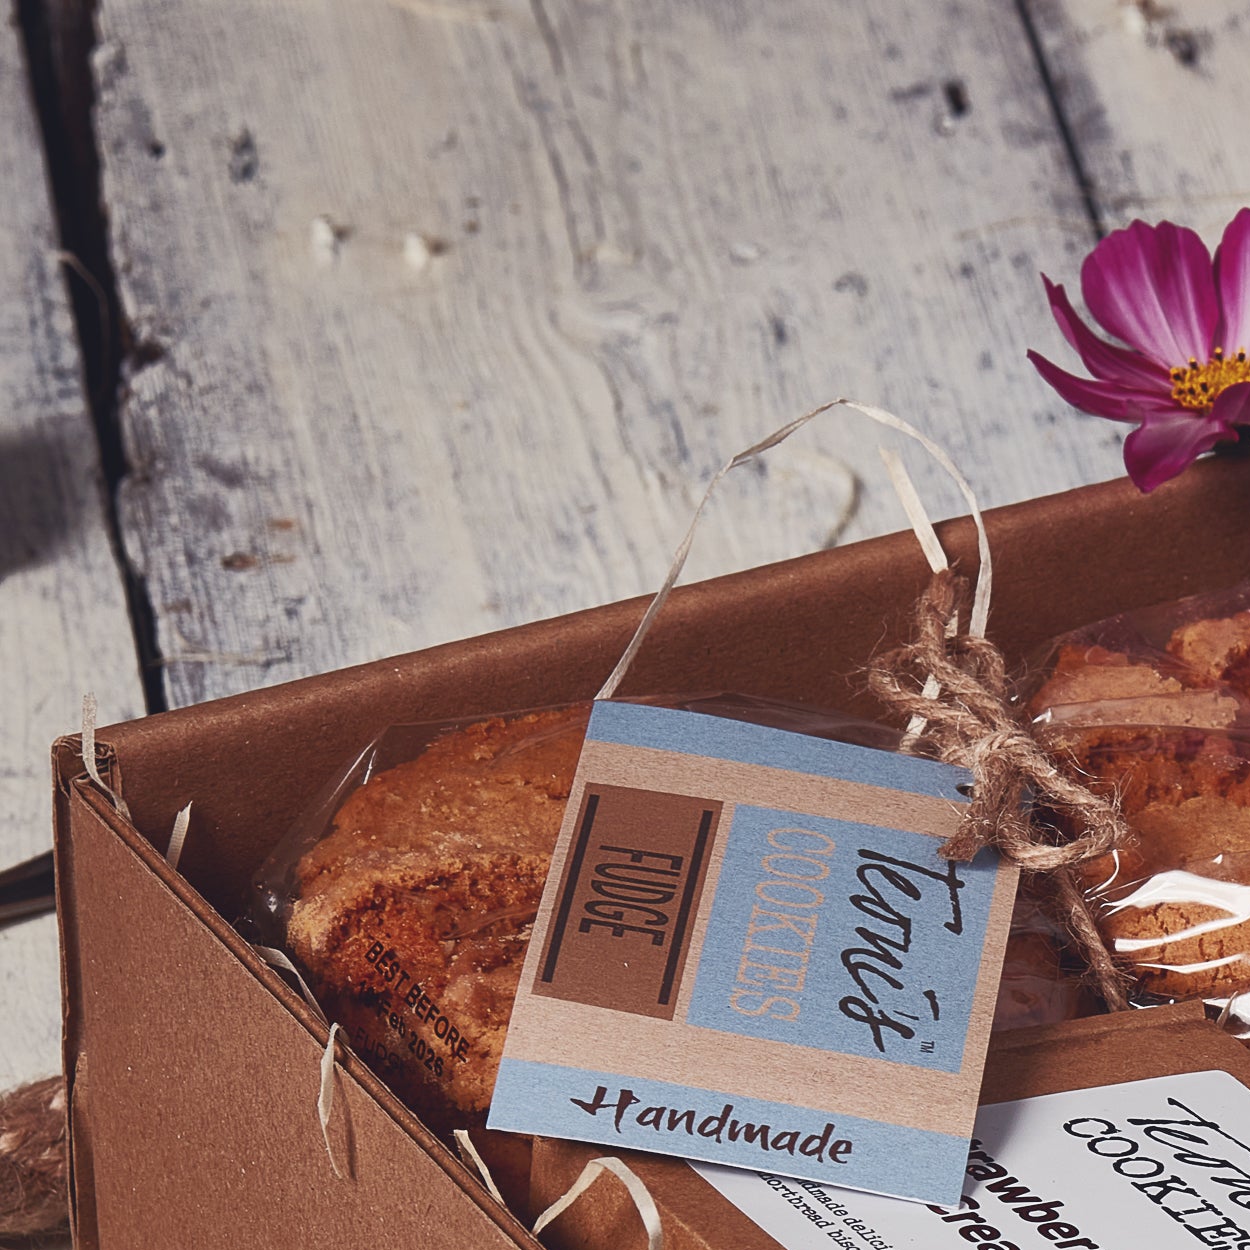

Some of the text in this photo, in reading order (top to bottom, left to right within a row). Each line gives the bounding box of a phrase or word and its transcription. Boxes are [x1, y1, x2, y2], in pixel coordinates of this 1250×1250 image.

[576, 842, 683, 947] FUDGE
[730, 826, 837, 1024] COOKIES
[839, 848, 965, 1053] Teoni's
[364, 940, 471, 1064] BEST BEFORE
[569, 1085, 854, 1166] Handmade
[756, 1171, 835, 1229] hortbread
